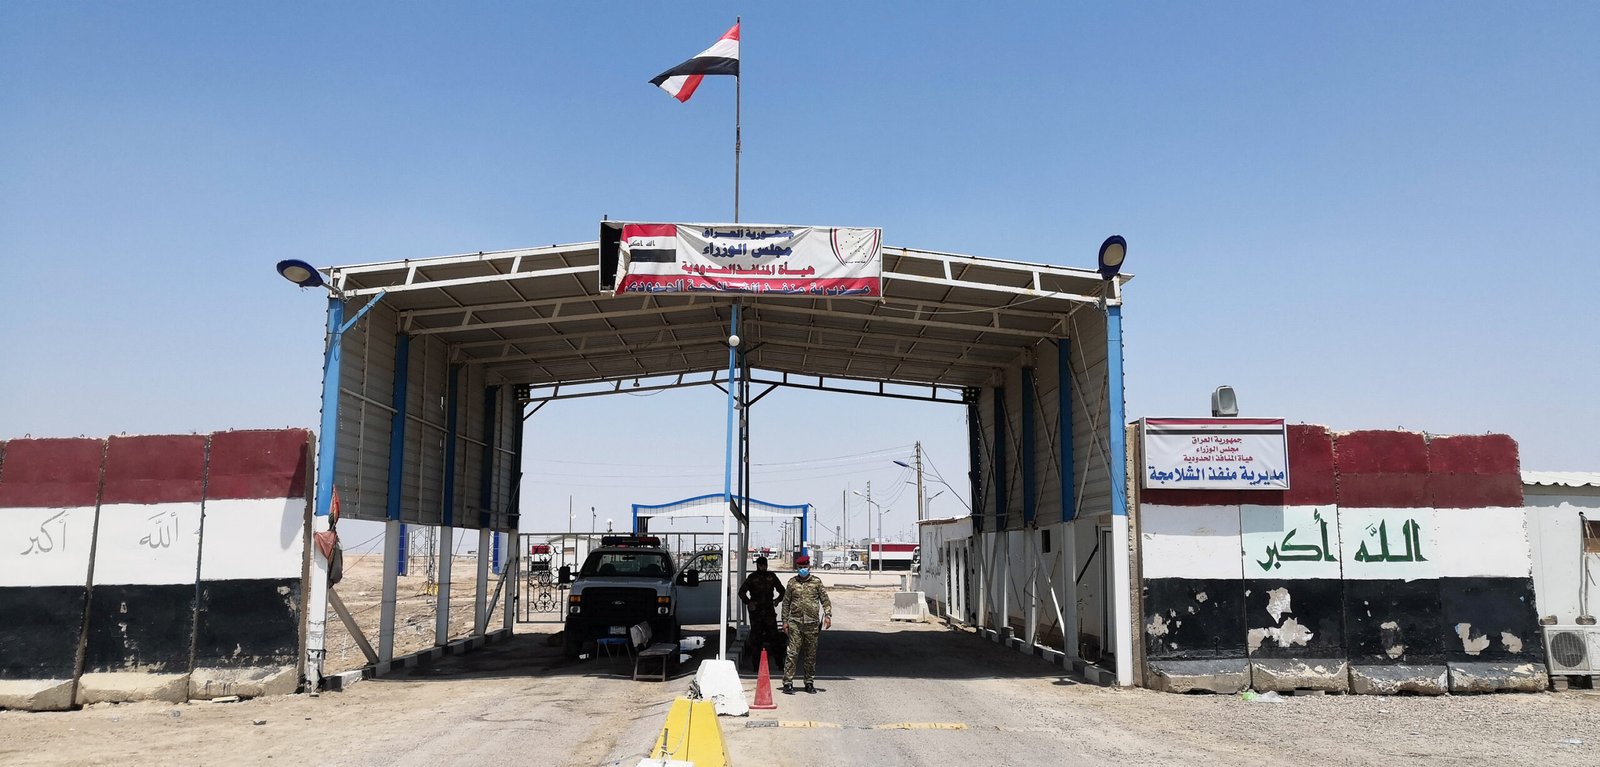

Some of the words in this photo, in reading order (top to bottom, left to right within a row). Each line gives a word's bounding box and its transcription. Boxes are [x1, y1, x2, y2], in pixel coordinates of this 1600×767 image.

[701, 227, 744, 239] العراق
[745, 228, 794, 240] جمهورية
[702, 241, 747, 258] الوزراء
[751, 242, 793, 258] مجلس
[778, 261, 815, 276] هيأة
[762, 280, 806, 295] منفذ
[1191, 436, 1213, 444] العراق
[1214, 436, 1242, 445] جمهورية
[1196, 446, 1218, 454] الوزراء
[1219, 446, 1239, 454] مجلس
[1183, 454, 1214, 463] الحدودية
[1215, 454, 1237, 462] المنافذ
[1238, 454, 1254, 463] هيأة
[1148, 465, 1205, 484] الشلامجة
[1208, 466, 1238, 482] منفذ
[1239, 465, 1285, 486] مديرية
[1256, 508, 1339, 572] أكبر
